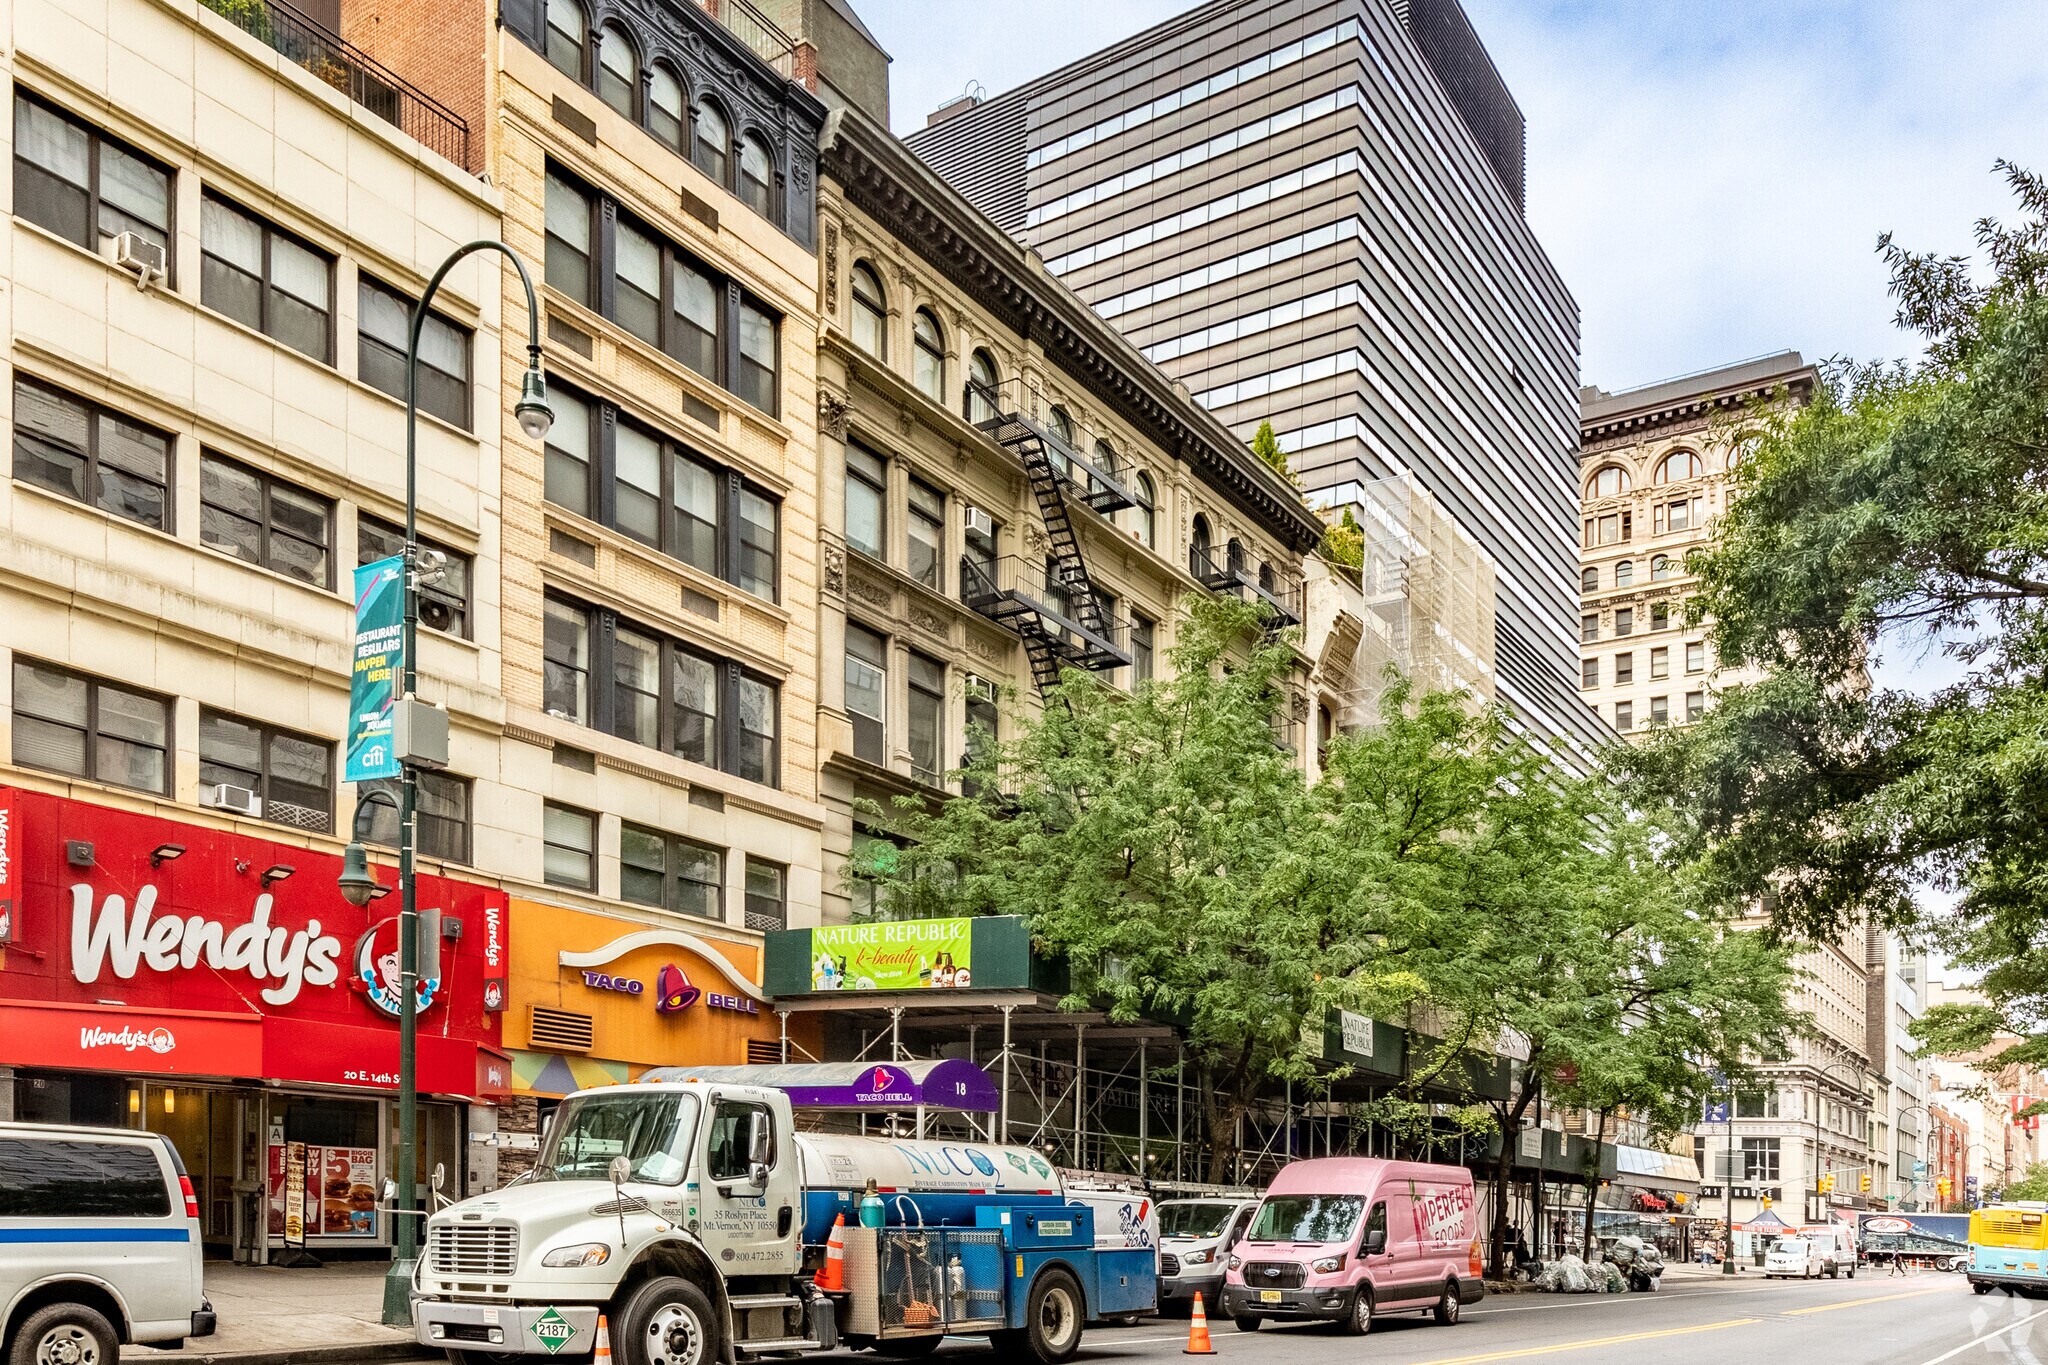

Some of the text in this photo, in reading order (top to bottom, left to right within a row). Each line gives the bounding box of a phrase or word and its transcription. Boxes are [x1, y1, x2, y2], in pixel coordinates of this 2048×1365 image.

[358, 638, 401, 658] REGULARS
[355, 655, 386, 672] HAPPEN
[368, 668, 391, 683] HERE
[362, 745, 384, 767] citi
[485, 907, 502, 967] Wendy's
[816, 922, 966, 945] NATURE REPUBLIC
[70, 883, 342, 1006] Wendy's
[855, 945, 921, 974] k-beauty
[581, 970, 760, 1014] TACO BELL
[1344, 1016, 1371, 1035] NATURE
[80, 1025, 147, 1051] Wendy's
[34, 1079, 44, 1088] 20
[344, 1071, 401, 1084] 20 E. 14th S
[955, 1082, 967, 1096] 18
[856, 1093, 912, 1102] TACO BELL
[272, 1128, 281, 1139] A
[351, 1156, 373, 1164] BAG
[714, 1210, 767, 1221] 35 Roslyn Place
[743, 1222, 755, 1230] NY
[757, 1221, 777, 1230] 10550
[1435, 1220, 1465, 1249] FOODS
[736, 1250, 784, 1262] 800.472.2855
[538, 1323, 567, 1336] 2187
